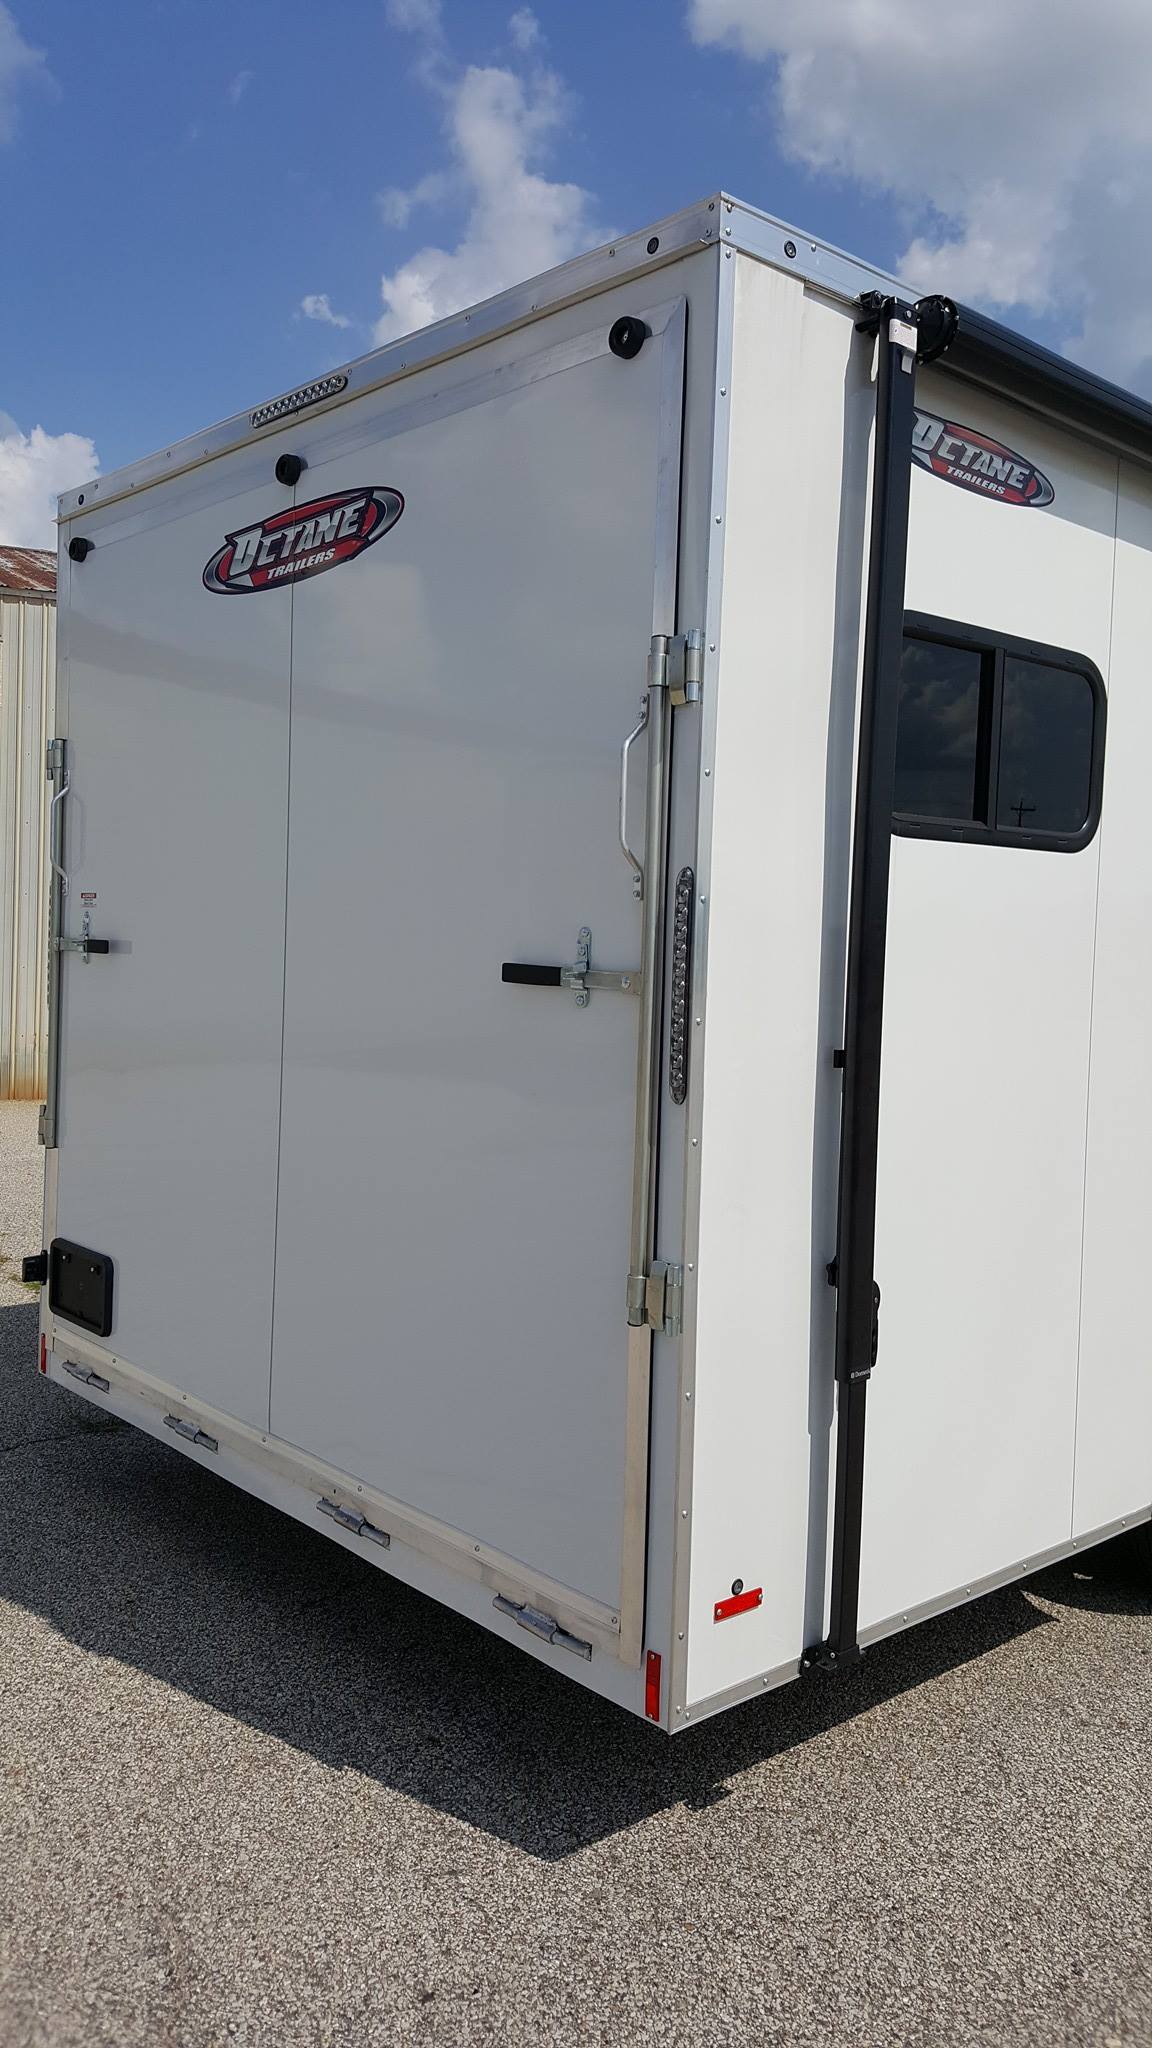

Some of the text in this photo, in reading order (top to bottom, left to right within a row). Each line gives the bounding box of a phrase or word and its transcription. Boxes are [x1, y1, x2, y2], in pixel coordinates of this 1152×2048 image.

[911, 411, 1030, 489] OCTANE
[946, 465, 1006, 495] TRAILERS
[227, 497, 367, 577] OCTANE
[267, 548, 336, 580] TRAILERS
